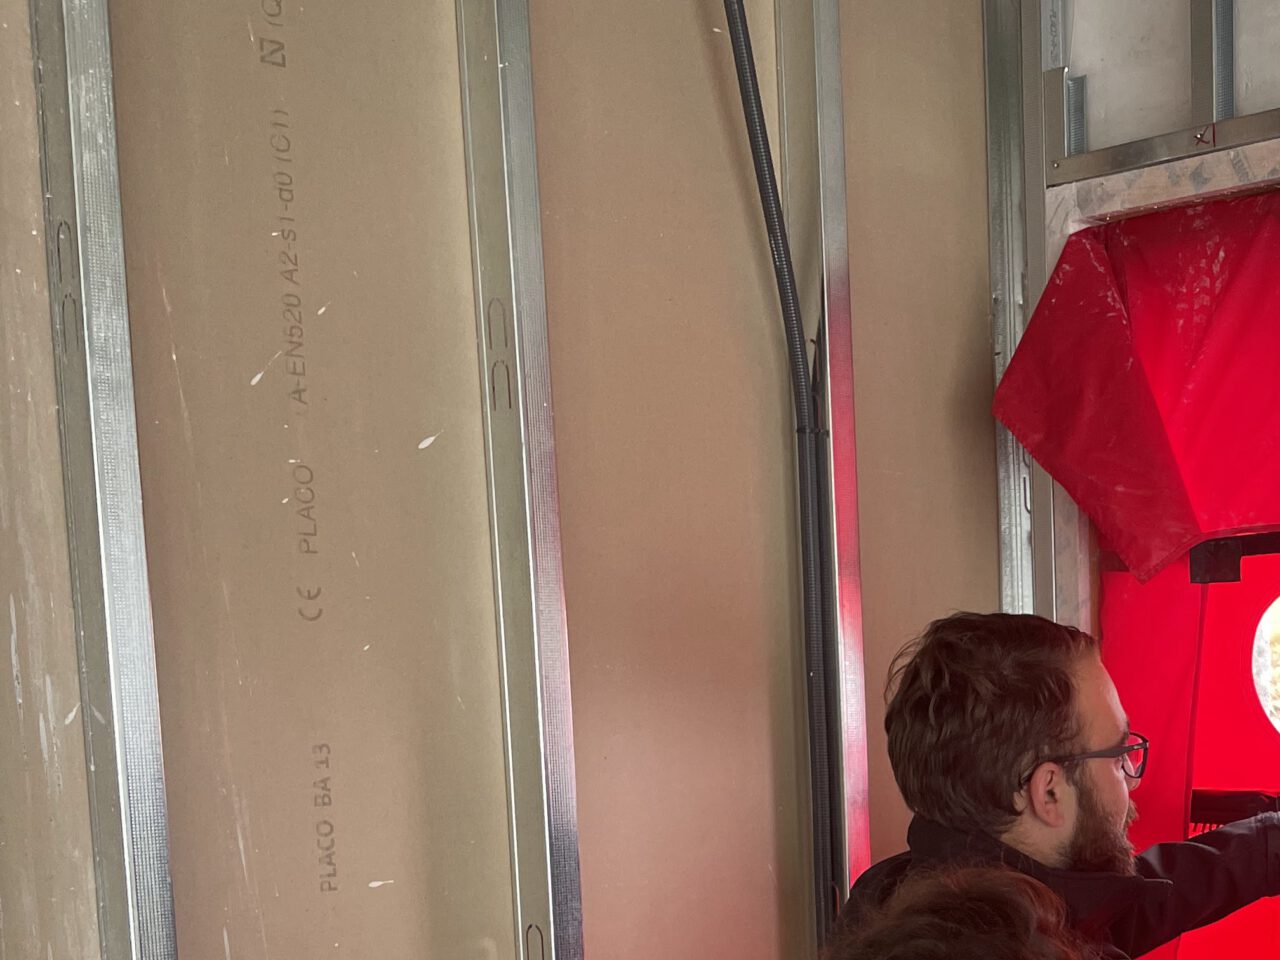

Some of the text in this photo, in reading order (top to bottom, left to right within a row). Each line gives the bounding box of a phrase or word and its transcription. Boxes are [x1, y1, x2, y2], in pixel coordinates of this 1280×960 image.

[292, 464, 319, 554] PLACO
[311, 743, 338, 893] PLACO BA 13
